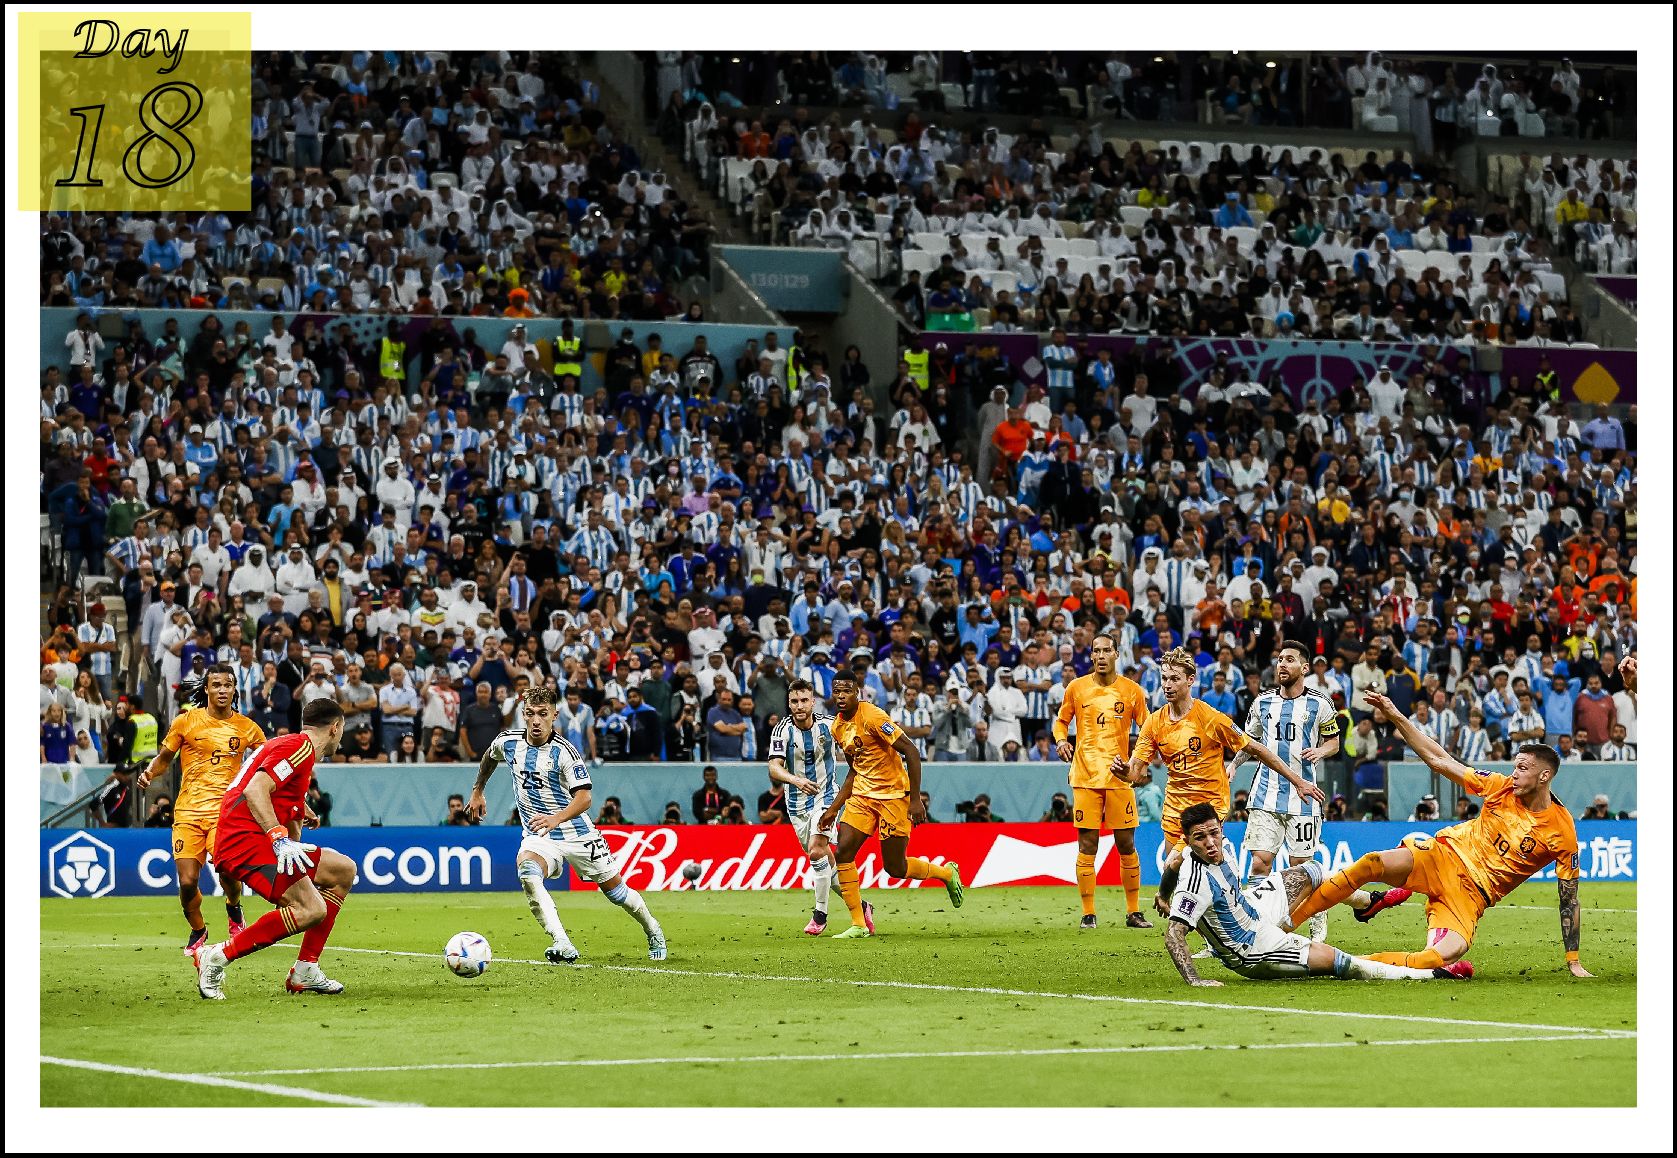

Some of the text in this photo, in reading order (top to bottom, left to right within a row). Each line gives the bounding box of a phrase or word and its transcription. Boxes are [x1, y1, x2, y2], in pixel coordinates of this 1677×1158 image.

[1096, 712, 1106, 728] 4
[1274, 721, 1297, 742] 10
[210, 749, 222, 766] 5
[519, 770, 545, 790] 25
[1125, 800, 1134, 817] 4
[1294, 821, 1314, 843] 10
[1491, 833, 1511, 858] 19
